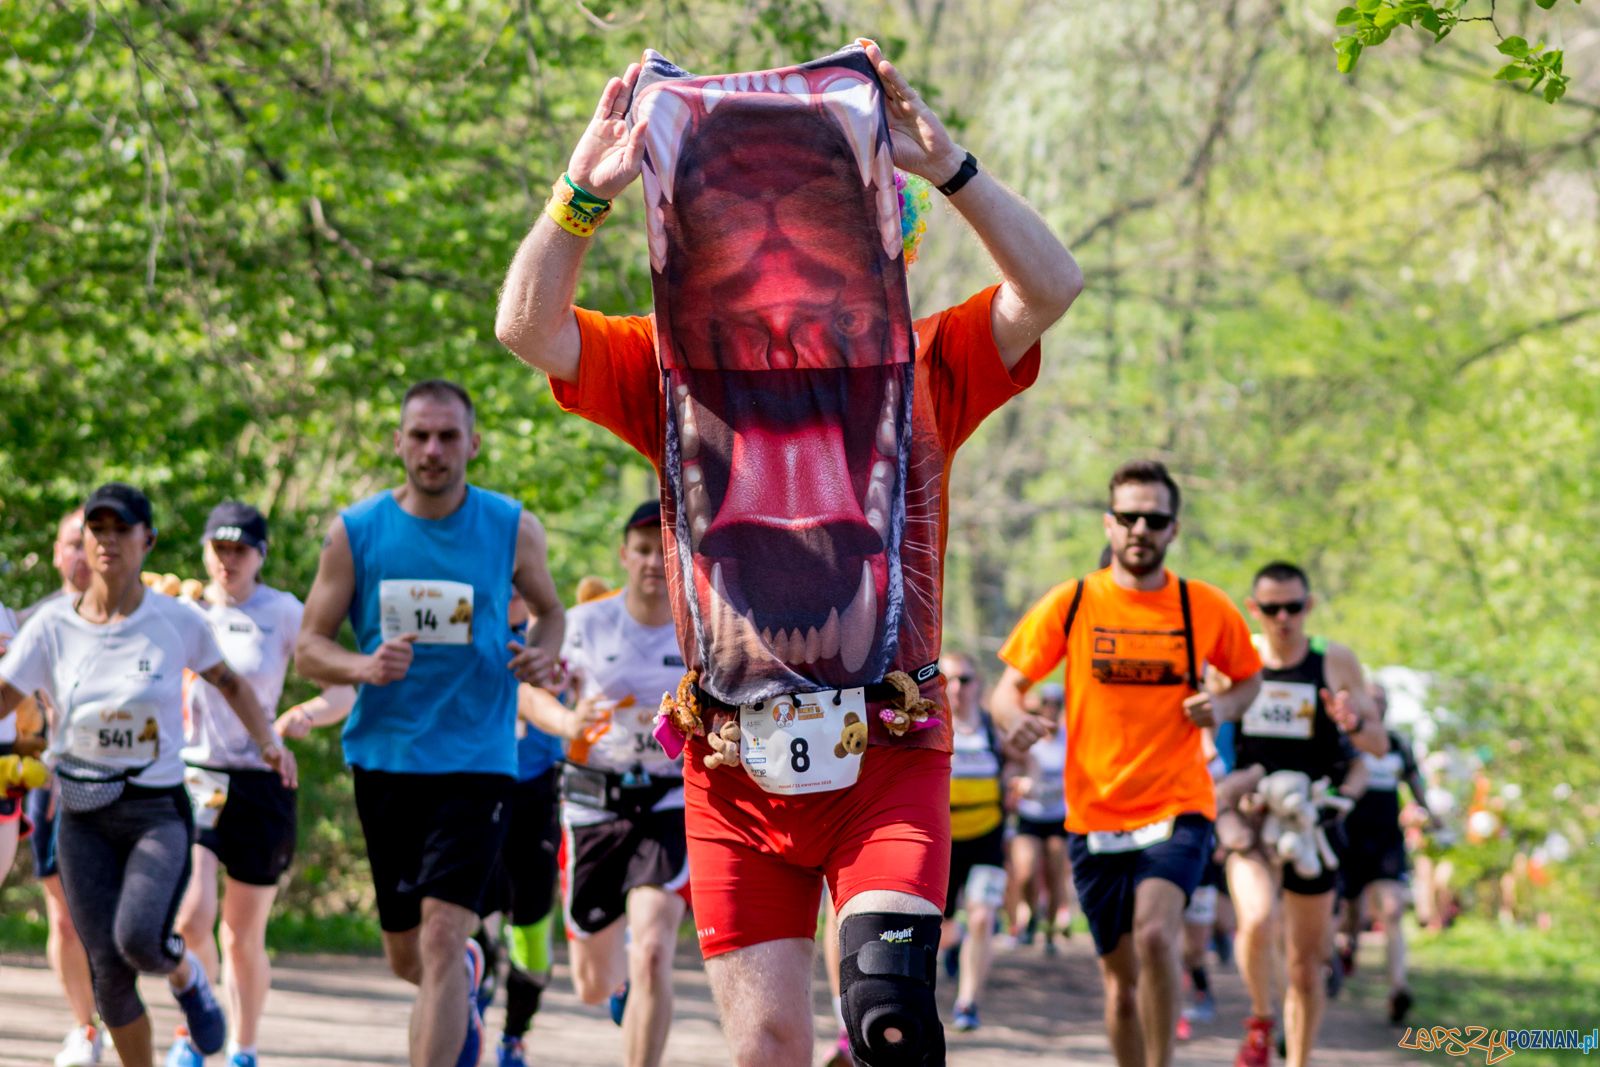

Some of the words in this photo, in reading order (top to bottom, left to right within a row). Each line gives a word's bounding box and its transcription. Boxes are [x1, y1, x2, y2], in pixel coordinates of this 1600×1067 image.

[415, 608, 438, 630] 14
[99, 728, 133, 748] 541
[634, 732, 664, 753] 34
[790, 737, 811, 773] 8
[880, 928, 912, 940] Allright
